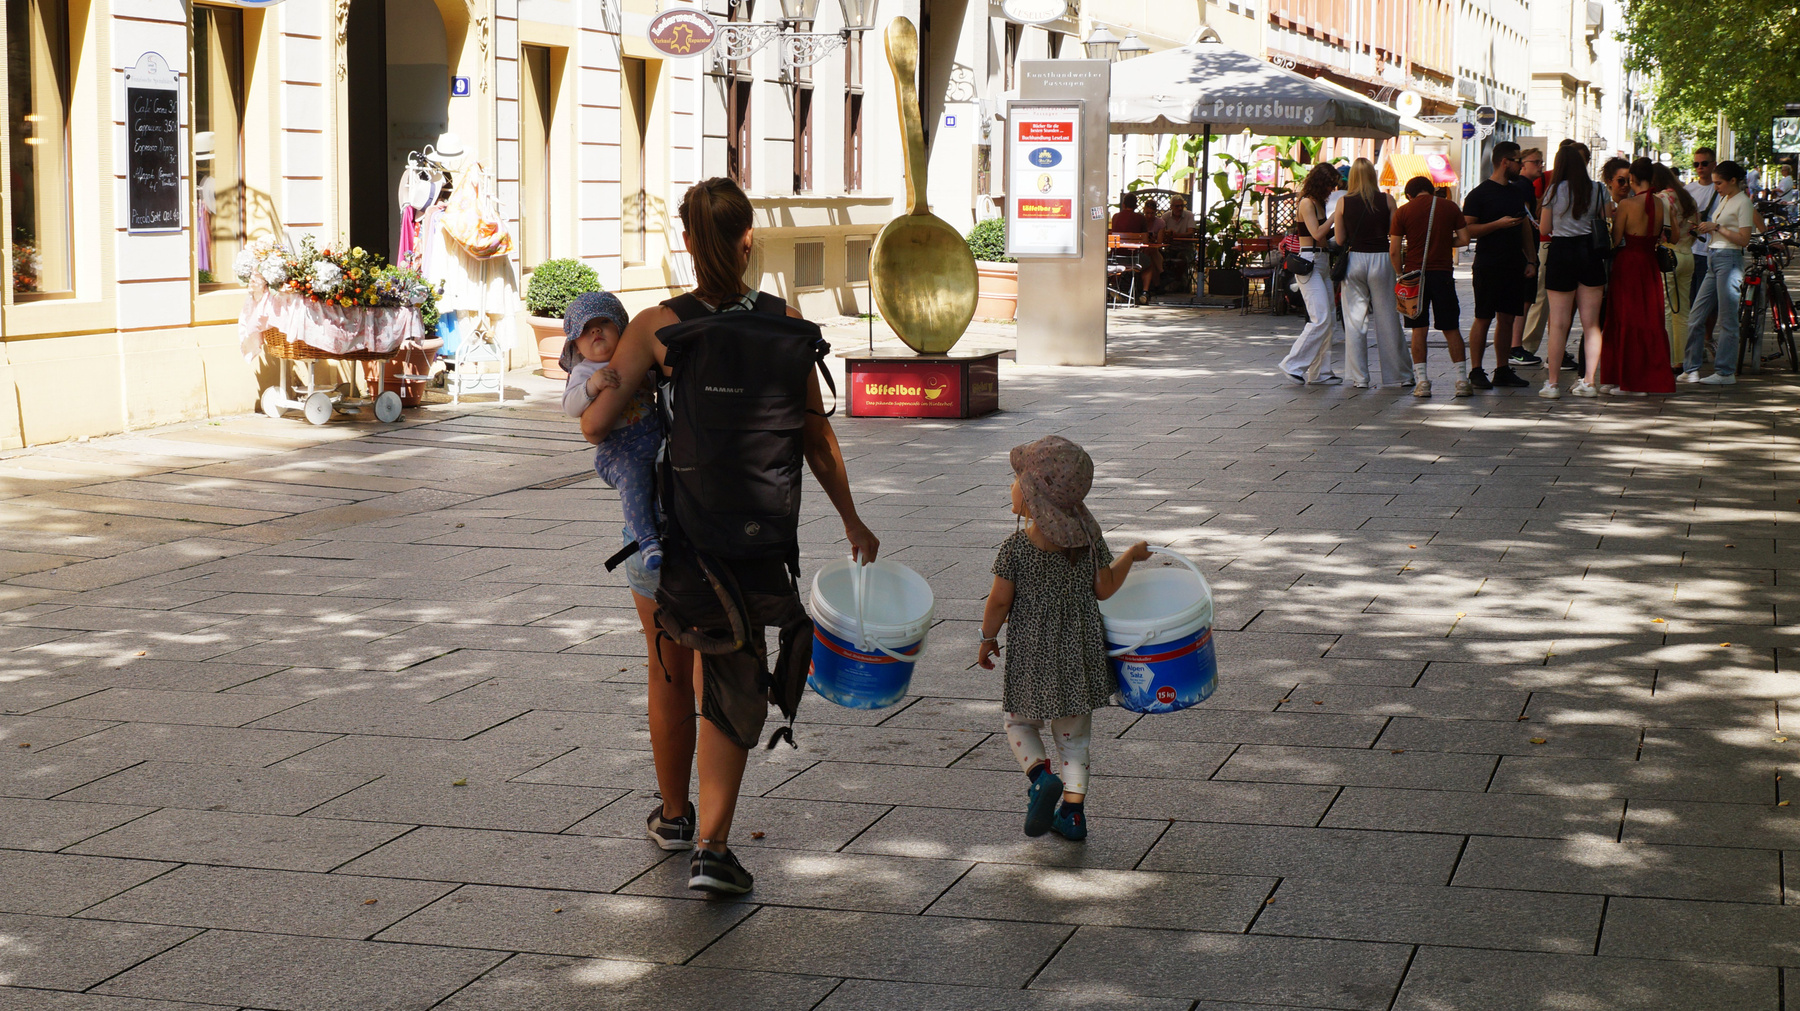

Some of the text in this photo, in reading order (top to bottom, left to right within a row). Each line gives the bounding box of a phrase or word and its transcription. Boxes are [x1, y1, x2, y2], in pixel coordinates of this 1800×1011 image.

[456, 79, 466, 93] 9
[1213, 100, 1314, 125] Petersburg
[1127, 664, 1145, 672] Alpen
[1130, 671, 1143, 679] Salz
[1157, 691, 1175, 699] 15 kg
